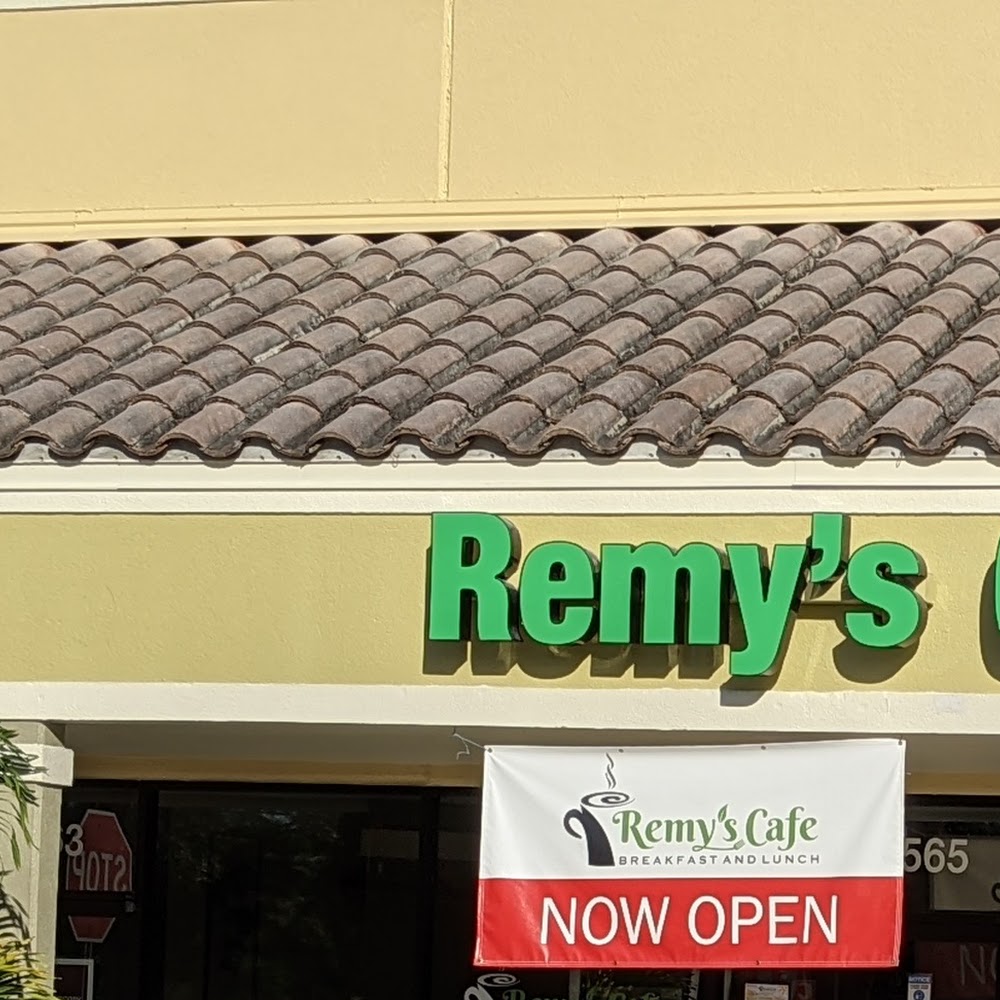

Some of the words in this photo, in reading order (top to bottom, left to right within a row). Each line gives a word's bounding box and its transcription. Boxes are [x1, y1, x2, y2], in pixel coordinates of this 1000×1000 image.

[427, 510, 925, 677] Remy's
[612, 804, 745, 851] Remy's
[746, 805, 819, 851] Cafe
[618, 854, 719, 866] BREAKFAST
[722, 854, 761, 866] AND
[762, 853, 821, 865] LUNCH
[540, 895, 671, 946] NOW
[688, 894, 838, 946] OPEN
